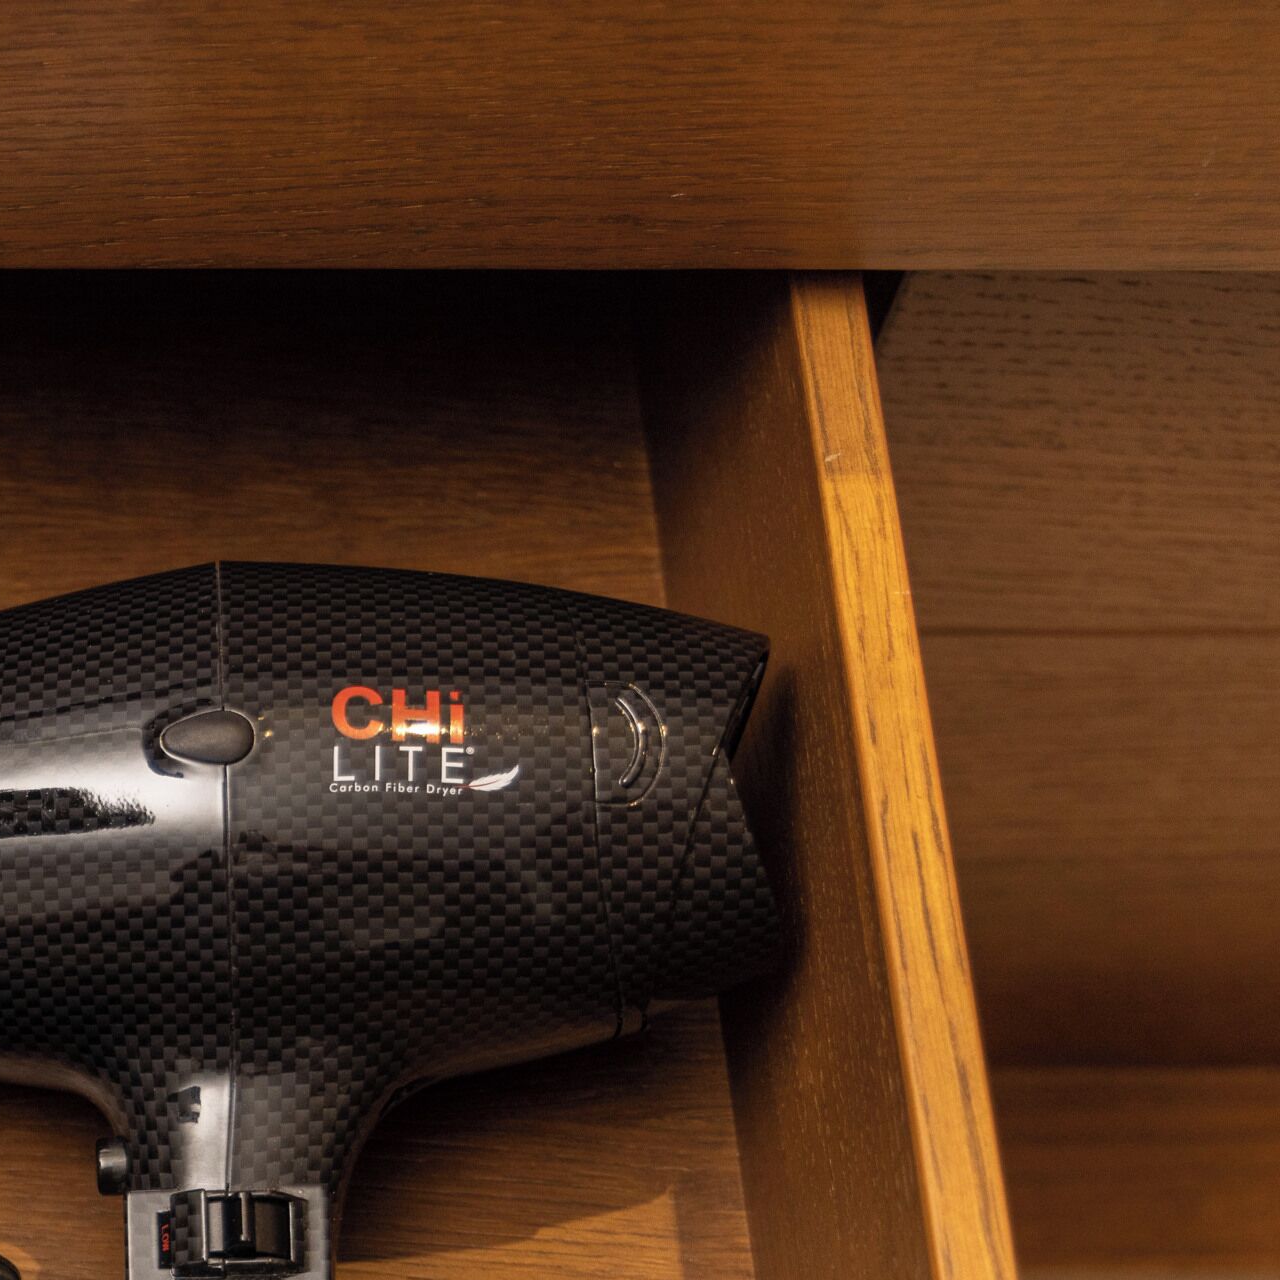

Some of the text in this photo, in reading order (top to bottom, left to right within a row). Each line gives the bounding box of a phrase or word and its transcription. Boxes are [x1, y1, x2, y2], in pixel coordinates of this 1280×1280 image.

[329, 782, 464, 797] Carbon Fiber Dryer
